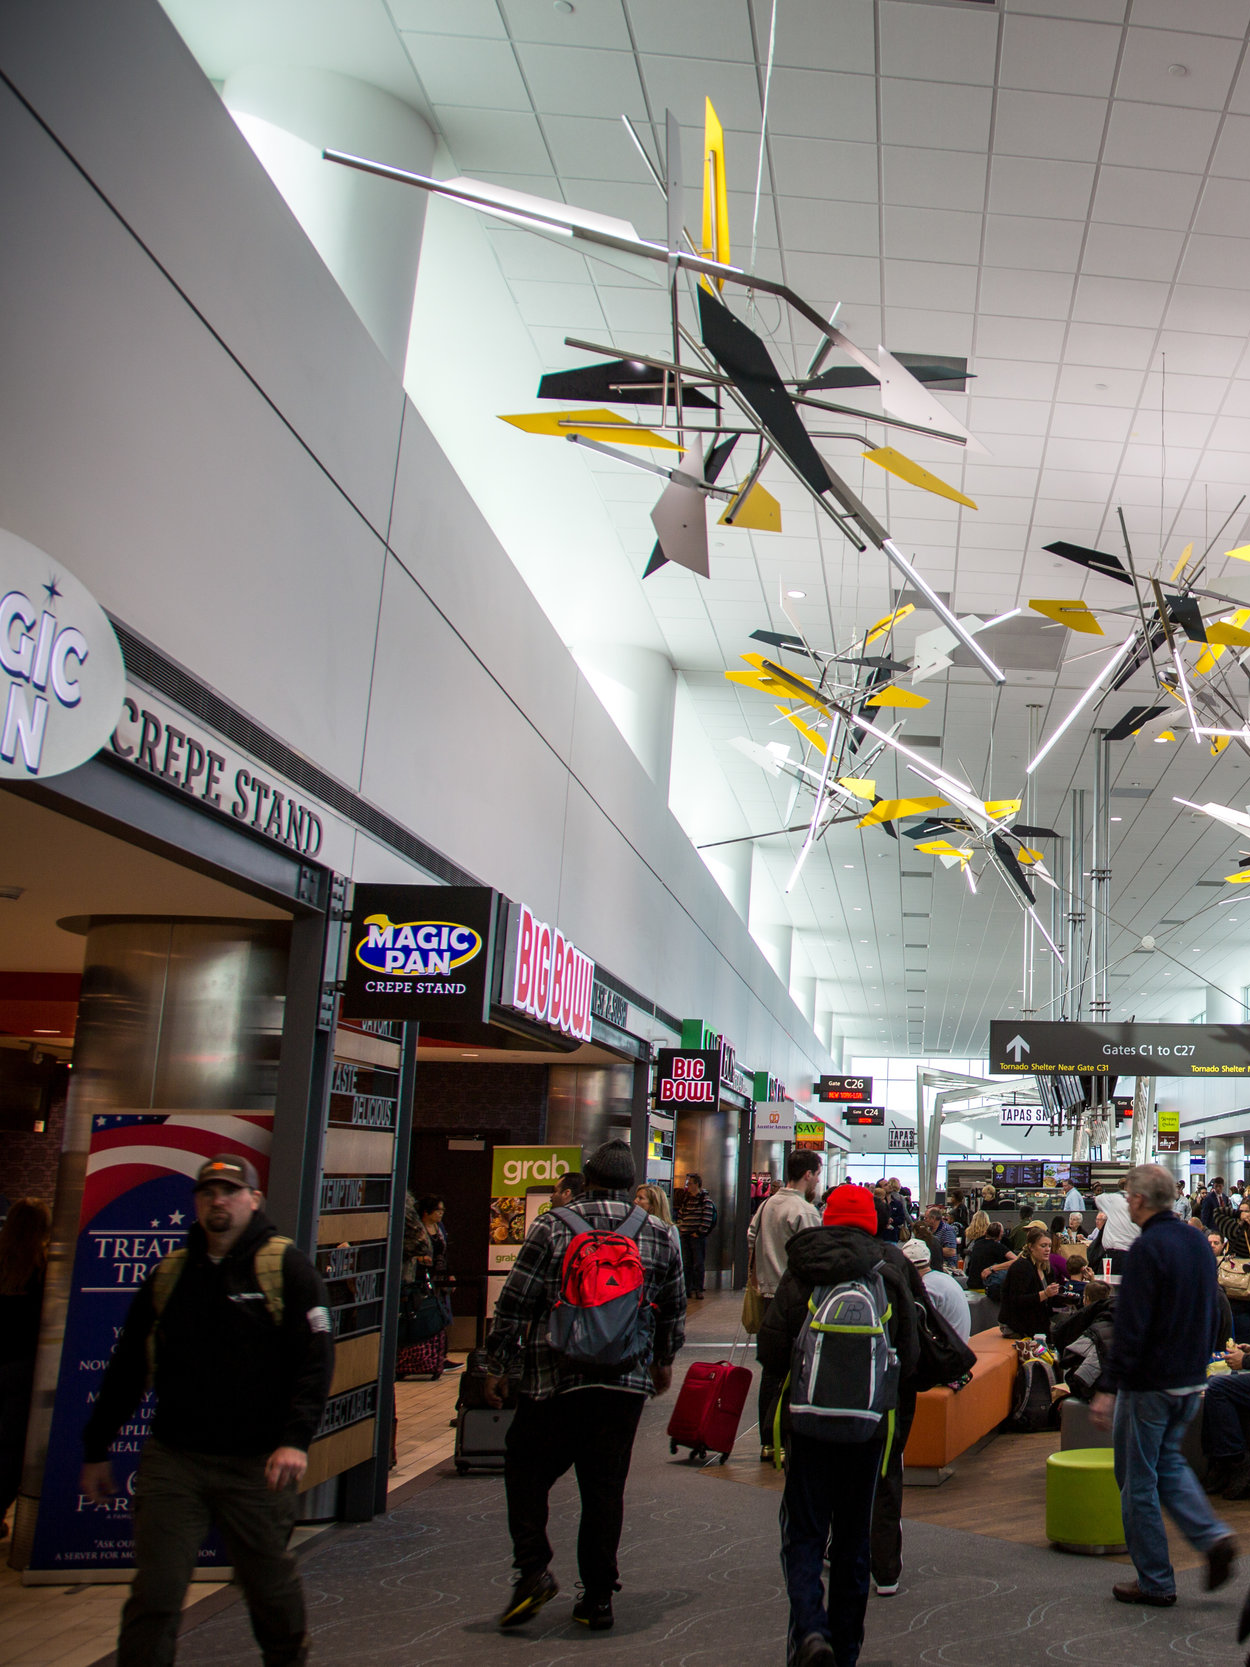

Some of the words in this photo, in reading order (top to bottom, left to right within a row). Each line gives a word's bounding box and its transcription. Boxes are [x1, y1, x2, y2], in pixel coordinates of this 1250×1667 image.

[110, 697, 226, 807] CREPE
[232, 769, 323, 858] STAND
[368, 925, 471, 950] MAGIC
[385, 950, 451, 975] PAN
[513, 903, 552, 1019] BIG
[548, 927, 595, 1042] BOWL
[365, 981, 412, 993] CREPE
[416, 982, 467, 994] STAND
[1102, 1044, 1136, 1056] Gates
[1139, 1044, 1153, 1056] C1
[1157, 1045, 1171, 1056] to
[1174, 1045, 1195, 1056] C27
[672, 1057, 705, 1080] BIG
[999, 1062, 1029, 1071] Tornado
[1031, 1063, 1056, 1071] Shelter
[1077, 1064, 1095, 1072] Gate
[1097, 1064, 1109, 1072] C31
[1191, 1065, 1220, 1073] Tornado
[1221, 1065, 1246, 1073] Shelter
[661, 1079, 714, 1102] BOWL
[844, 1079, 864, 1089] C26
[352, 1096, 392, 1126] DELICIOUS
[864, 1108, 878, 1116] C24
[1002, 1108, 1032, 1122] TAPAS
[797, 1124, 817, 1133] SAY
[890, 1130, 914, 1140] TAPAS
[503, 1153, 570, 1185] grab
[321, 1179, 363, 1209] TEMPTING
[94, 1237, 181, 1258] TREAT
[355, 1273, 377, 1303] SOUR
